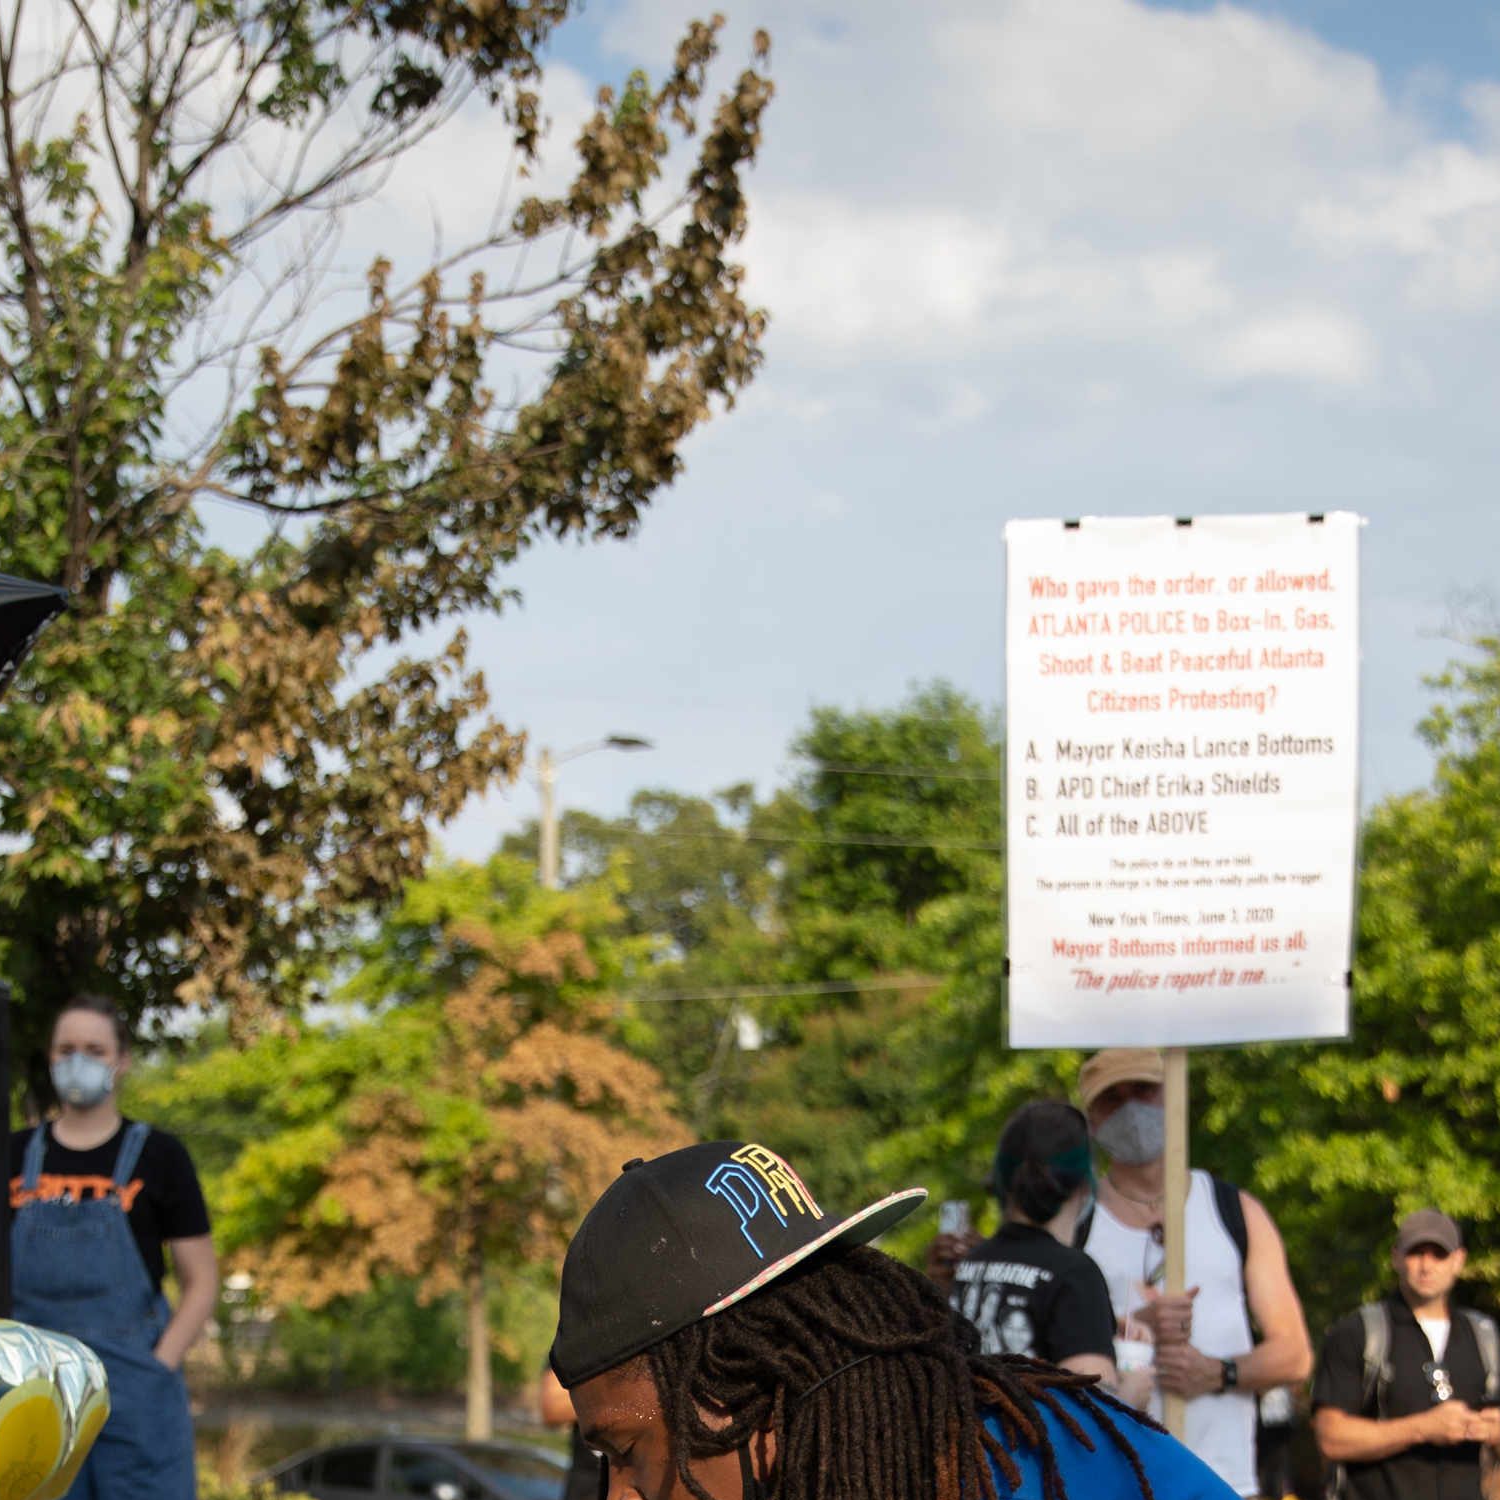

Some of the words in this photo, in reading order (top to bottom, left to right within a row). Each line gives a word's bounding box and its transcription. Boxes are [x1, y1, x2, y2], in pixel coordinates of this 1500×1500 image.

[1028, 576, 1068, 599] Who
[1076, 578, 1120, 603] gave
[1128, 575, 1156, 596] the
[1229, 576, 1247, 594] or
[1028, 612, 1111, 637] ATLANTA
[1119, 610, 1186, 634] POLICE
[1193, 612, 1210, 632] to
[1039, 653, 1093, 676] Shoot
[1100, 653, 1113, 674] &
[1121, 651, 1162, 674] Beat
[1170, 648, 1252, 672] Peaceful
[1259, 647, 1324, 670] Atlanta
[1088, 689, 1161, 713] Citizens
[1169, 685, 1277, 714] Protesting?
[1056, 740, 1113, 766] Mayor
[1122, 737, 1186, 760] Keisha
[1193, 736, 1250, 759] Lance
[1257, 734, 1334, 756] Bottoms
[1057, 777, 1093, 800] APD
[1101, 775, 1150, 798] Chief
[1156, 774, 1204, 797] Erika
[1211, 771, 1281, 795] Shields
[1056, 814, 1079, 836] All
[1086, 813, 1105, 835] of
[1110, 813, 1139, 834] the
[1146, 810, 1209, 834] ABOVE
[1088, 913, 1114, 928] New
[1119, 911, 1147, 927] York
[1197, 909, 1225, 925] June
[1245, 907, 1274, 922] 2020
[1052, 938, 1101, 963] Mayor
[1109, 936, 1175, 956] Bottoms
[1182, 934, 1255, 955] informed
[1261, 935, 1279, 950] us
[1106, 968, 1158, 994] police
[1162, 968, 1216, 993] report
[1219, 968, 1234, 988] to
